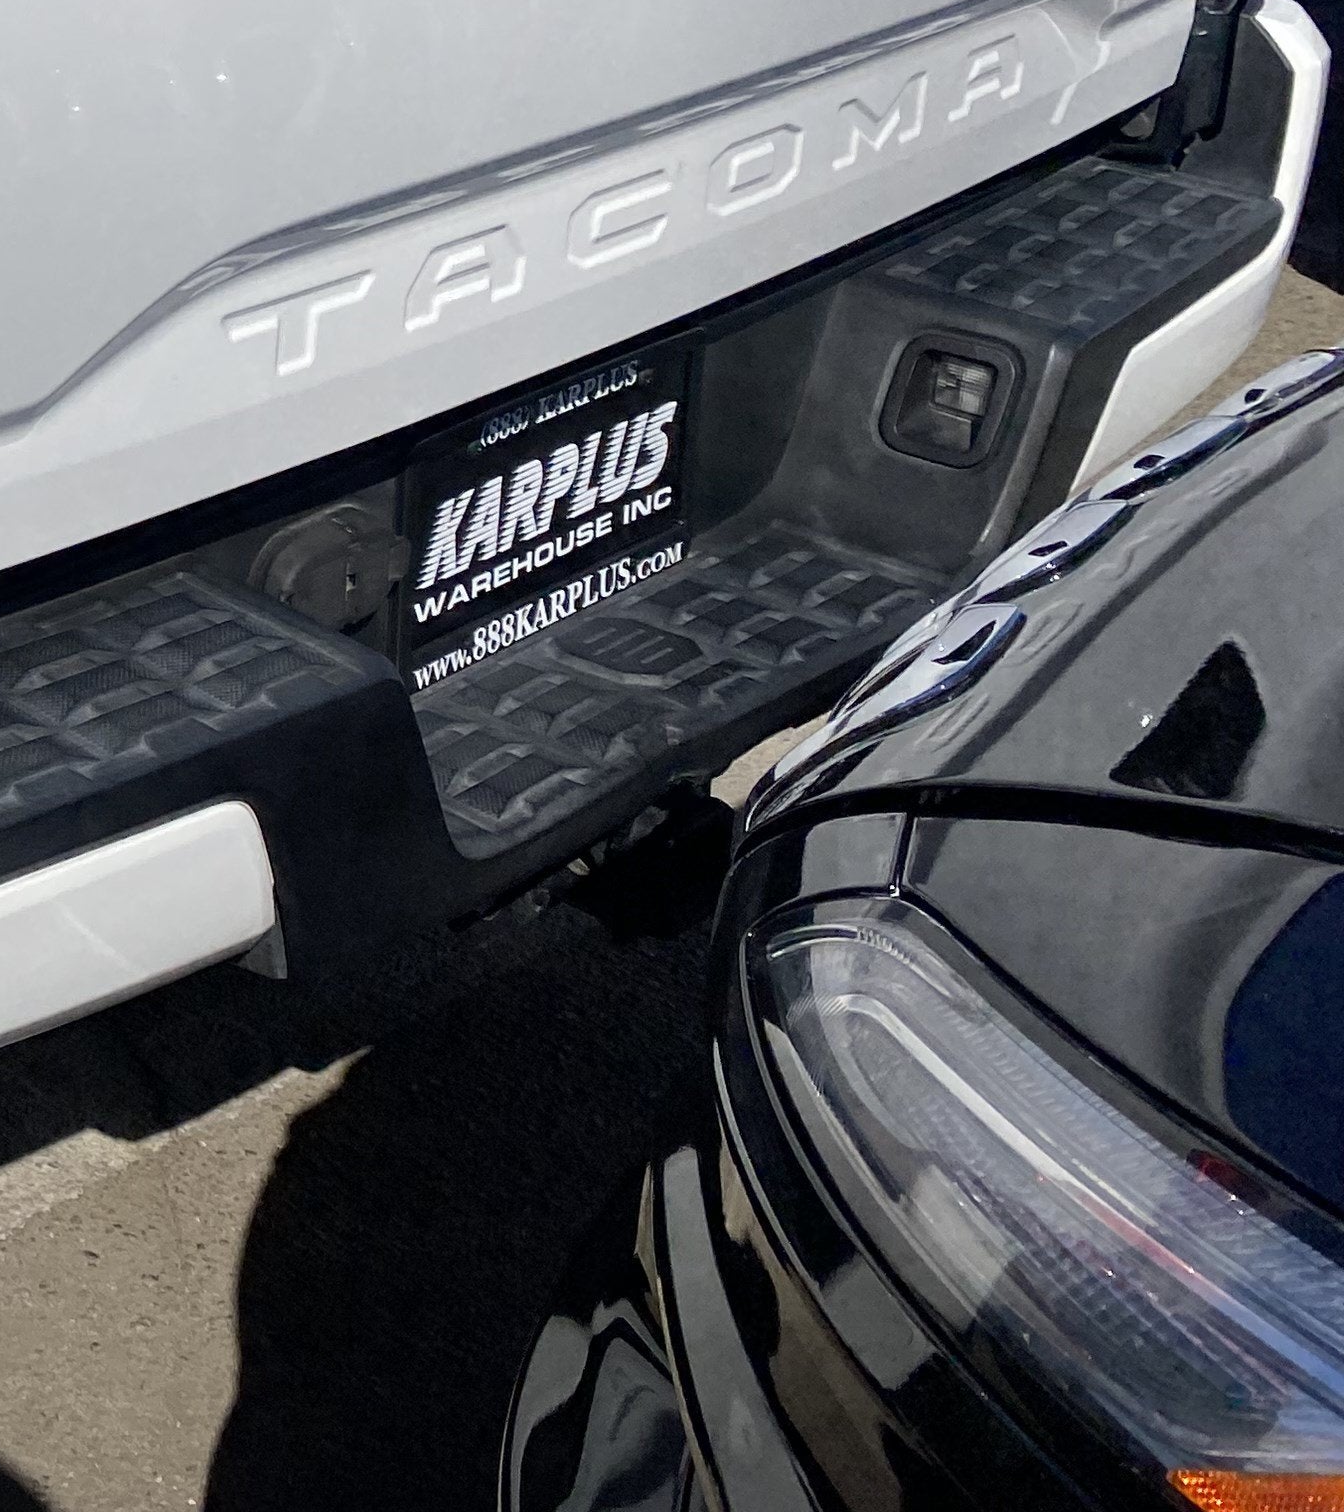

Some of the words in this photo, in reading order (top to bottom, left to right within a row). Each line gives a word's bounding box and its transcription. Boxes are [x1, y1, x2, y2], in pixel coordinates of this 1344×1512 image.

[220, 33, 1026, 376] TACOMA
[535, 360, 639, 424] KARPLUS
[414, 401, 678, 590] KARPLUS
[414, 512, 613, 623] WAREHOUSE
[622, 486, 673, 525] INC
